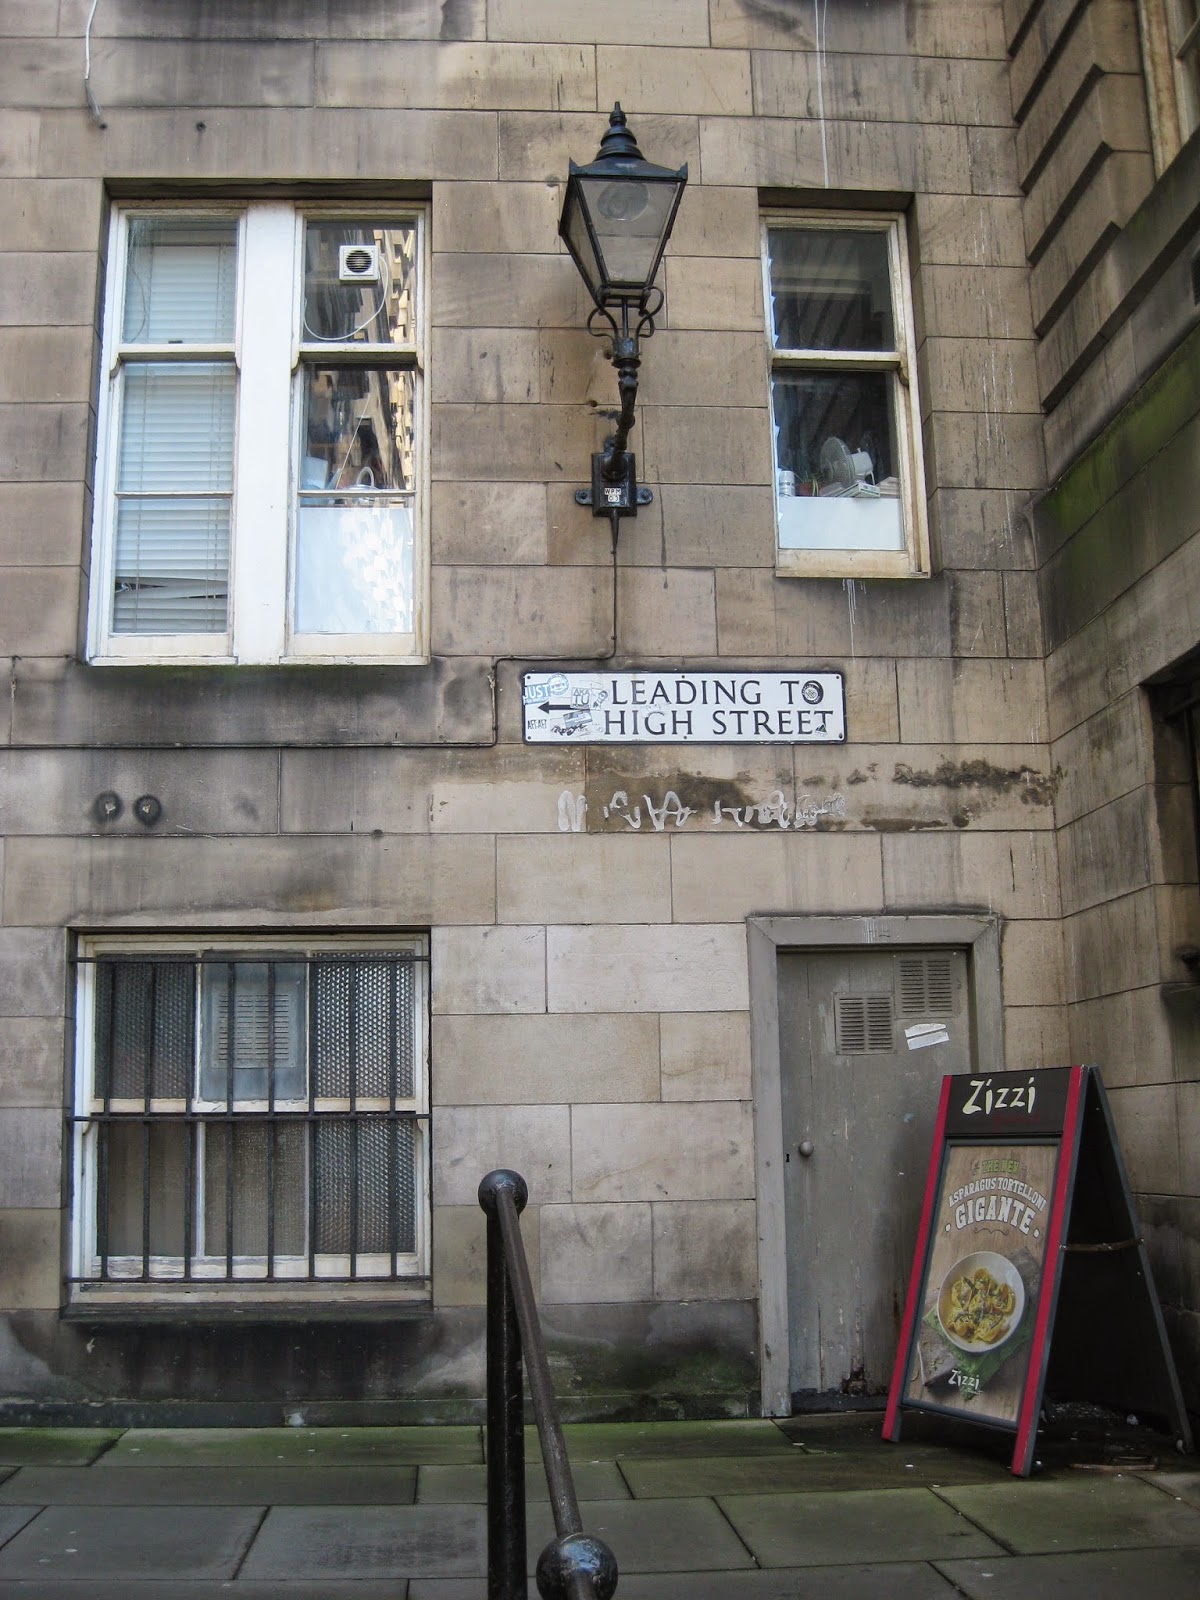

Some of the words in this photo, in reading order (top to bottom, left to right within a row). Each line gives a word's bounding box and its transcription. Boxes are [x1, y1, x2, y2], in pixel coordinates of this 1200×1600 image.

[523, 684, 550, 700] JUST
[612, 680, 761, 705] LEADING
[780, 679, 824, 705] TO
[604, 709, 693, 735] HIGH
[712, 709, 834, 735] STREET
[962, 1076, 1036, 1115] Zizzi
[982, 1159, 1000, 1174] THE
[1001, 1159, 1020, 1174] NEW
[948, 1178, 997, 1208] ASPARAGUS
[997, 1177, 1047, 1212] TORTELLONI
[955, 1195, 1036, 1235] GIGANTE
[947, 1369, 980, 1390] Zizzi
